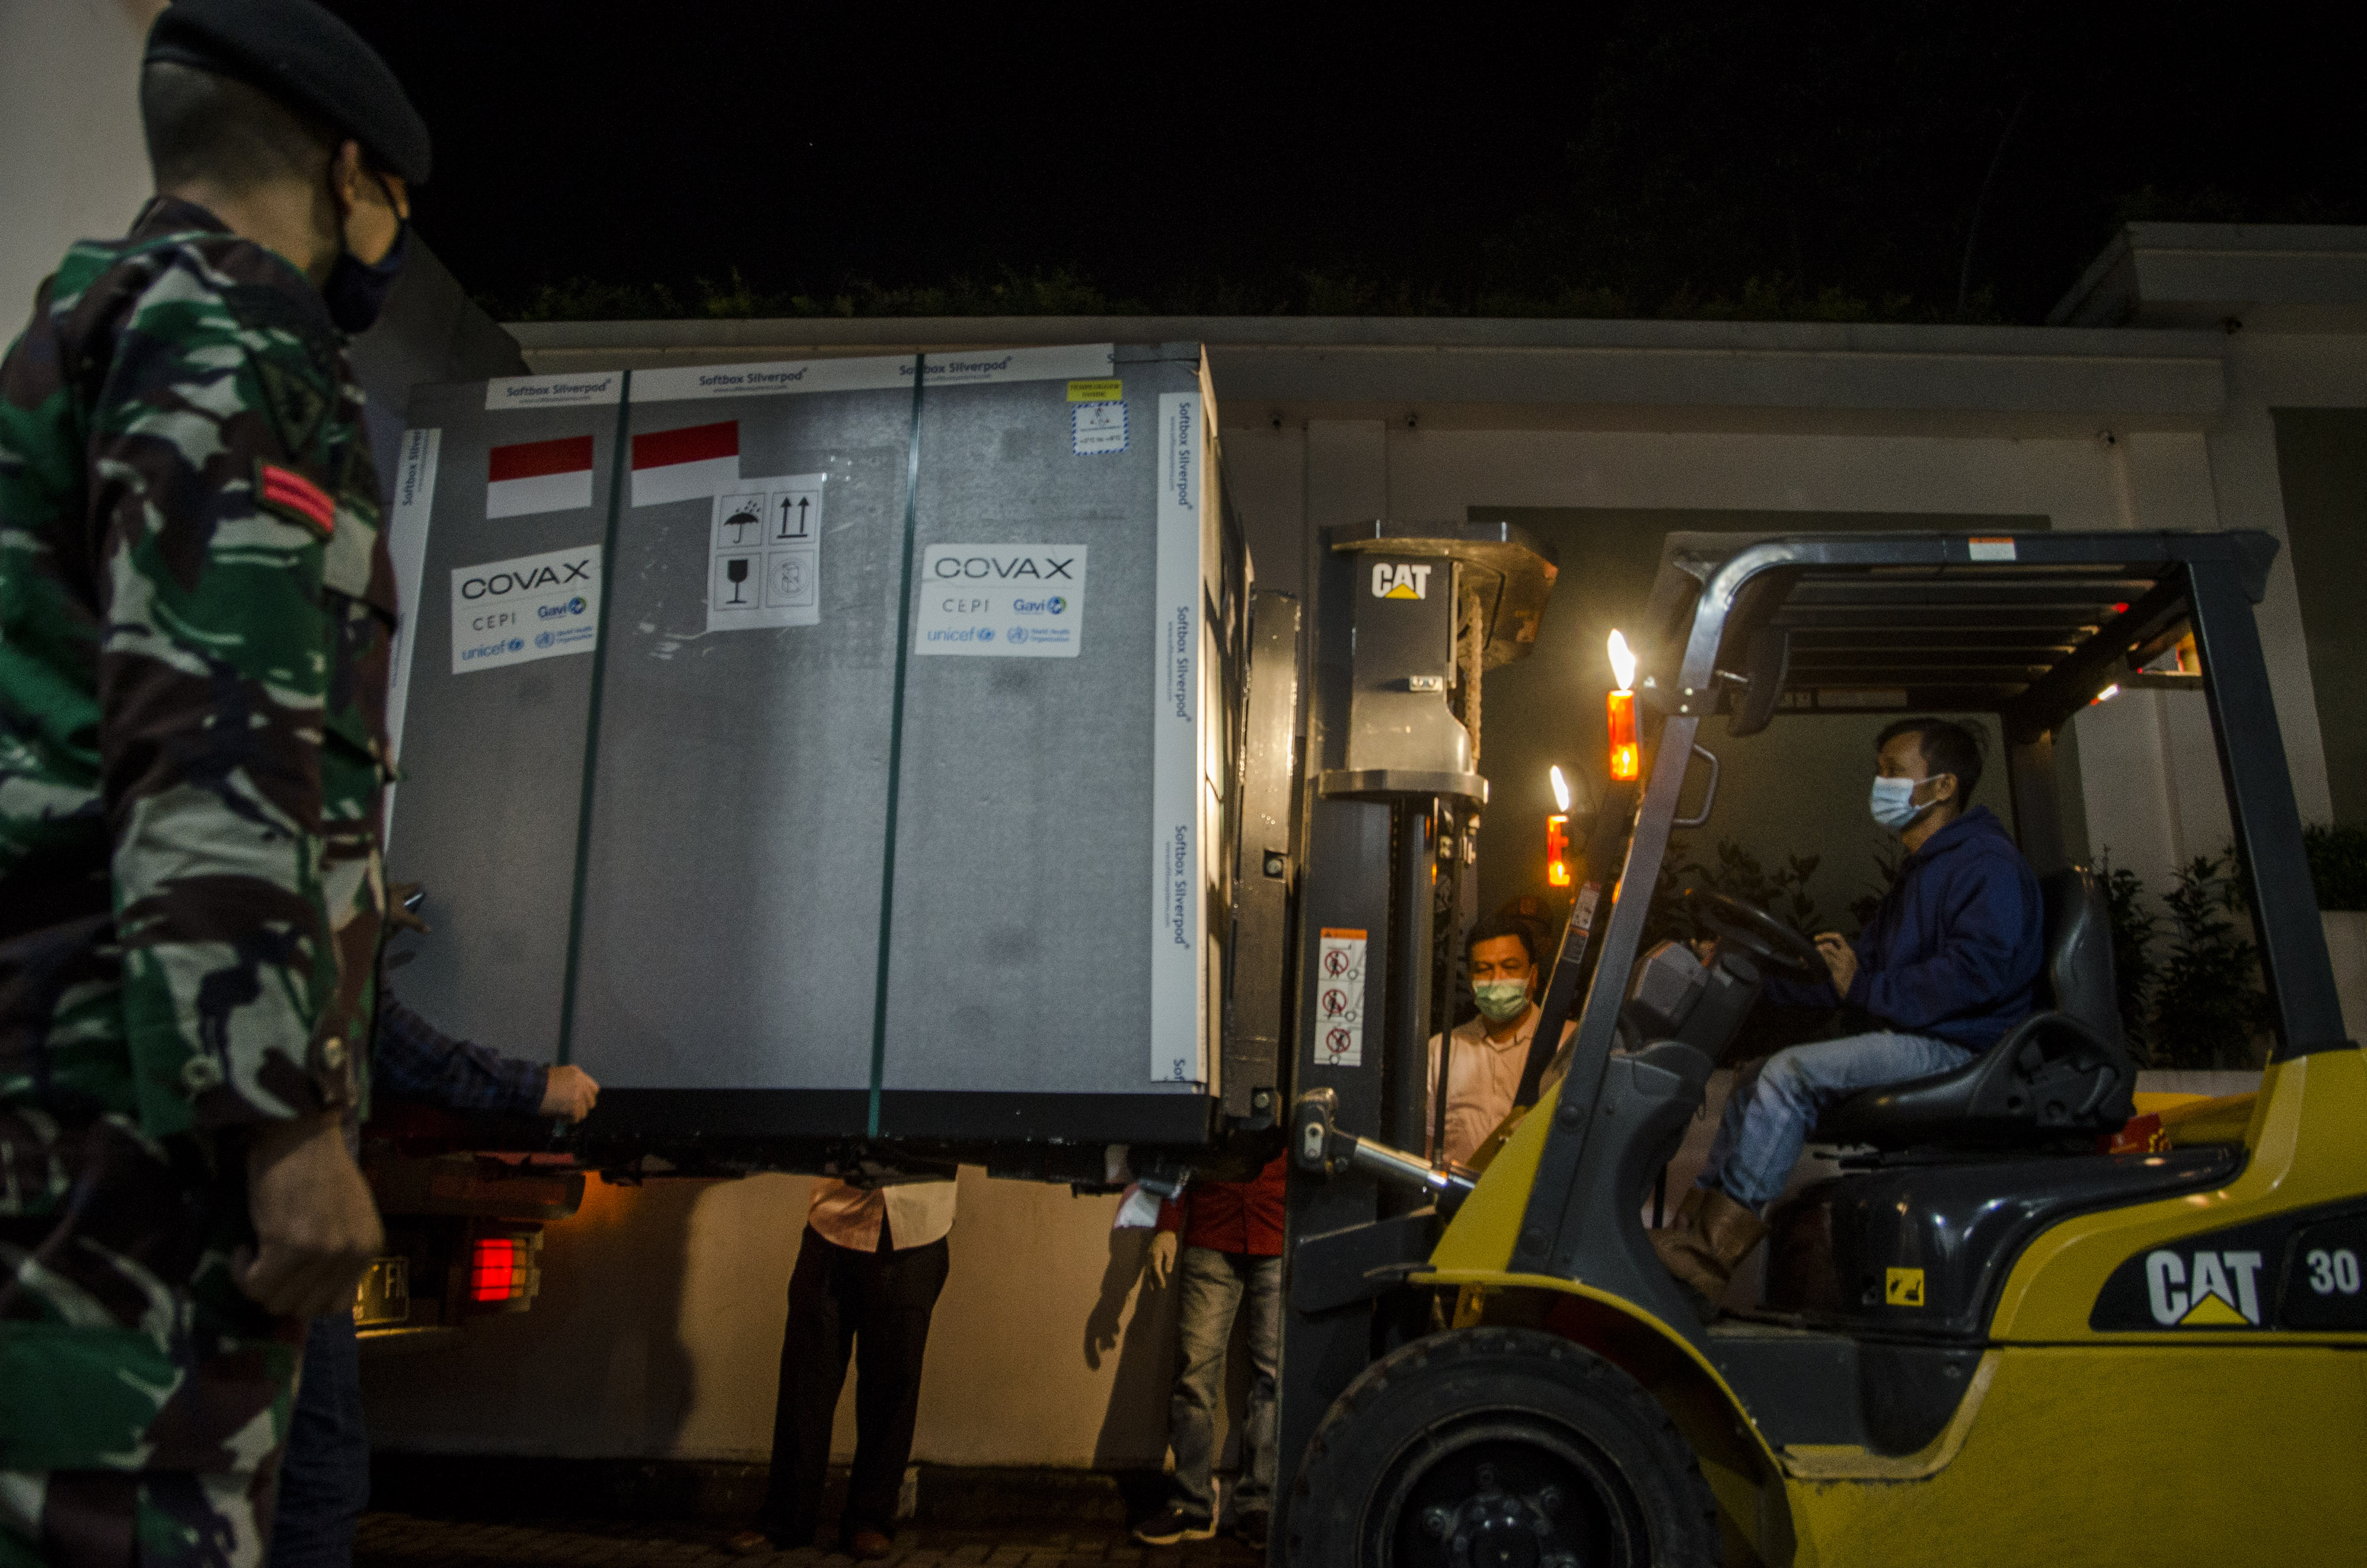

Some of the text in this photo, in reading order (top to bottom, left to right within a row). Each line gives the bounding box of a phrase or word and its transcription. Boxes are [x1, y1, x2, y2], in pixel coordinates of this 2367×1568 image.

[699, 374, 743, 386] Softbox
[507, 386, 550, 397] Softbox
[1179, 402, 1191, 446] Softbox
[935, 557, 1074, 579] COVAX
[462, 560, 589, 599] COVAX
[1372, 562, 1432, 600] CAT
[538, 603, 567, 618] Gavi
[942, 599, 989, 612] CEPI
[1013, 598, 1046, 612] Gavi
[473, 612, 515, 631] CEPI
[1176, 605, 1189, 653] Softbox
[927, 627, 976, 642] unicef
[462, 639, 506, 661] unicef
[1175, 825, 1188, 876] Softbox
[2307, 1248, 2361, 1295] 30
[2146, 1249, 2262, 1326] CAT
